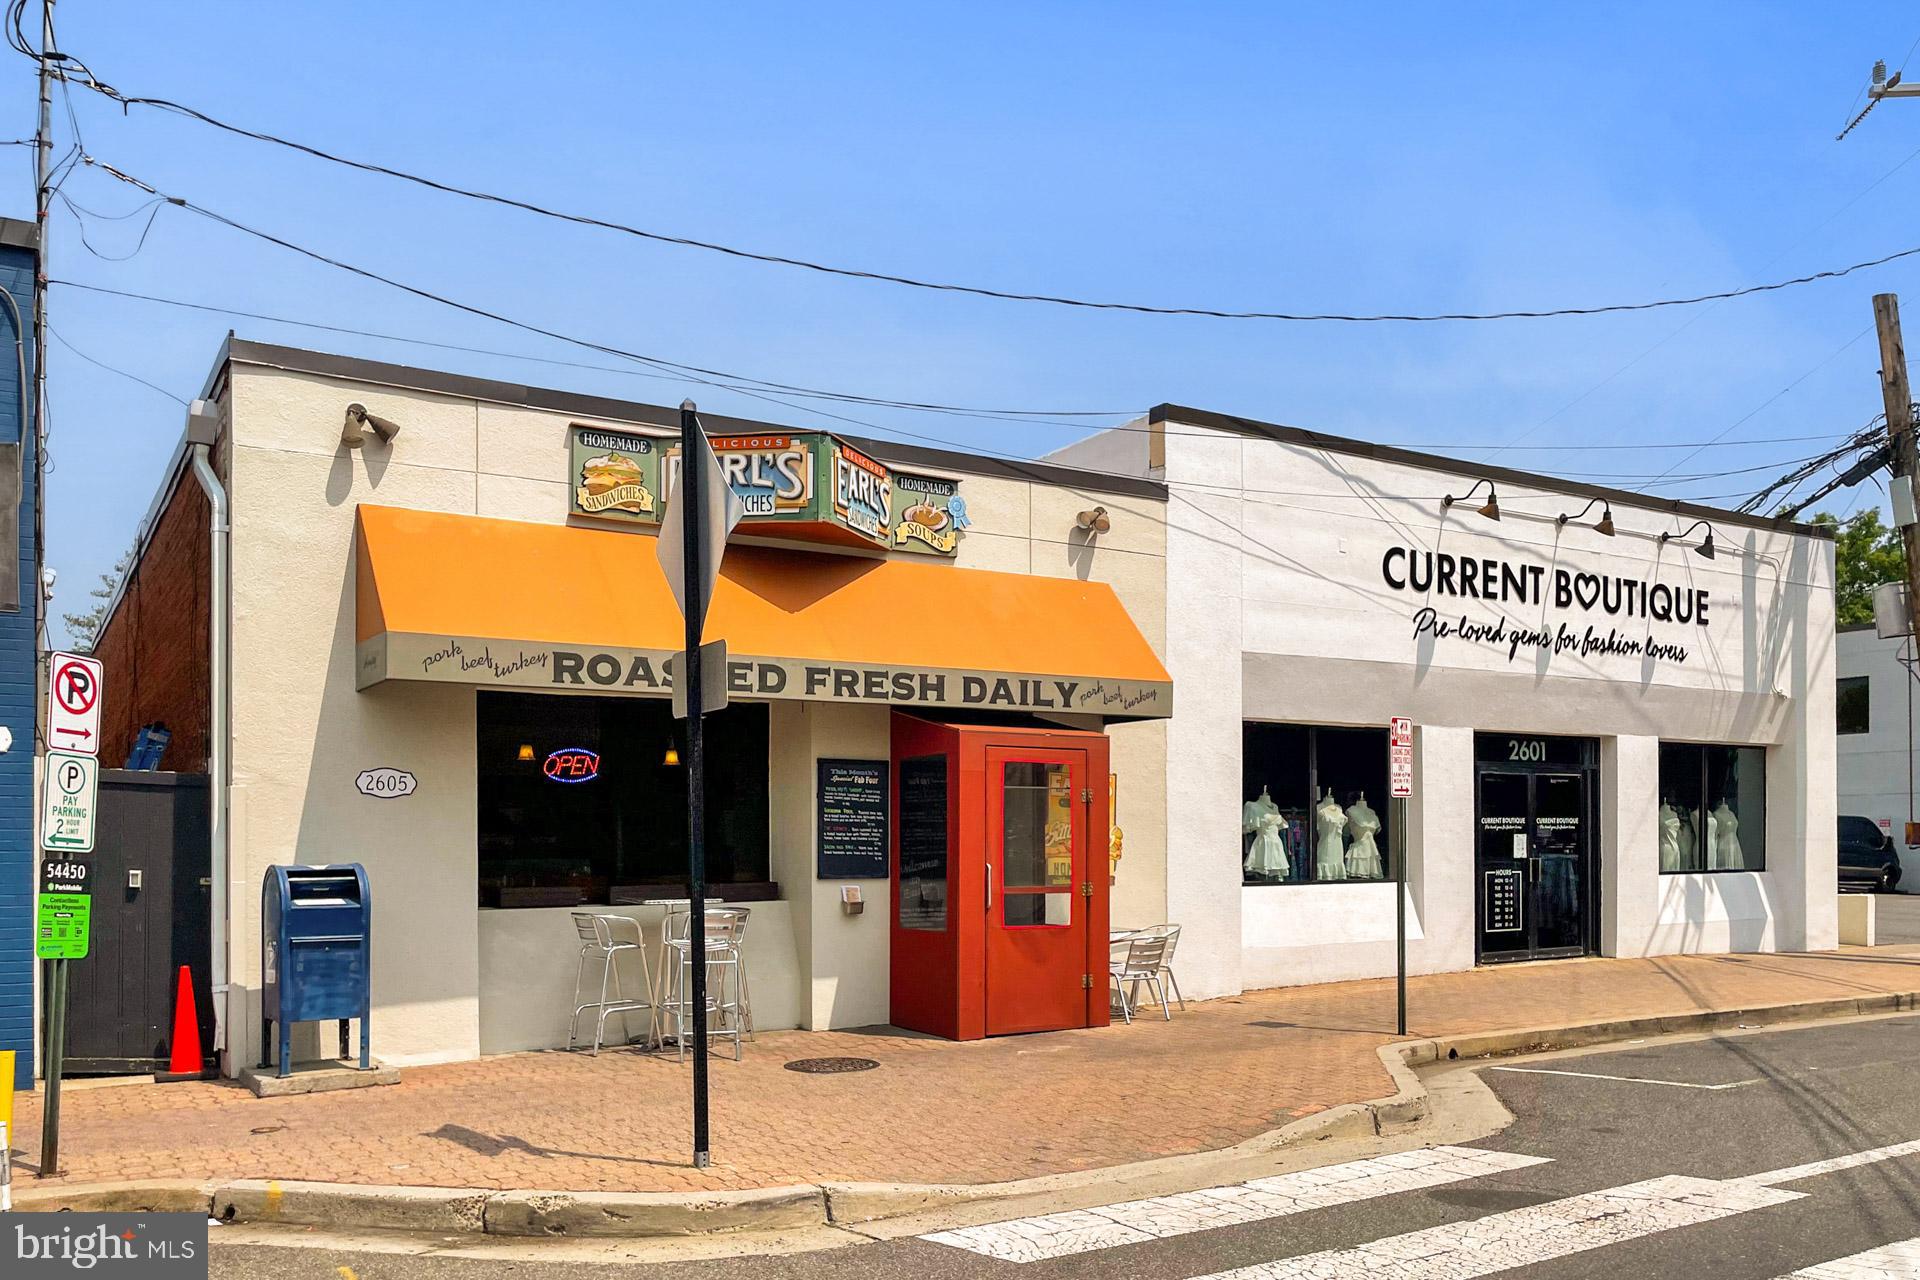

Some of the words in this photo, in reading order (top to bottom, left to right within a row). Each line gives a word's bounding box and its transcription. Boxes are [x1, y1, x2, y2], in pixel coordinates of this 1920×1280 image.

[583, 433, 648, 454] HOMEMADE
[712, 439, 783, 448] LICIOUS
[845, 449, 883, 475] DELICIOUS
[837, 457, 890, 527] EARL'S
[900, 477, 951, 495] HOMEMADE
[584, 488, 645, 511] SANDWICHES
[906, 522, 944, 548] SOUPS
[1382, 546, 1545, 605] CURRENT
[1412, 607, 1505, 643] Pre-loved
[1508, 629, 1552, 665] gems
[1552, 622, 1581, 655] for
[1581, 625, 1643, 657] fashion
[1645, 636, 1689, 663] lovers
[421, 640, 463, 672] pork
[460, 647, 493, 671] beef
[493, 652, 548, 679] turkey
[552, 651, 787, 694] ROAED
[805, 666, 946, 702] FRESH
[962, 676, 1079, 709] DAILY
[1079, 680, 1105, 706] pork
[1103, 685, 1122, 705] beef
[1122, 688, 1158, 710] turkey
[1508, 740, 1546, 761] 2601
[543, 755, 600, 775] OPEN
[67, 766, 79, 788] P
[365, 774, 408, 792] 2605
[854, 776, 865, 784] Fab
[865, 776, 879, 785] Four
[62, 795, 78, 806] PAY
[52, 806, 87, 818] PARKING
[56, 818, 64, 834] 2
[46, 863, 86, 879] 54450
